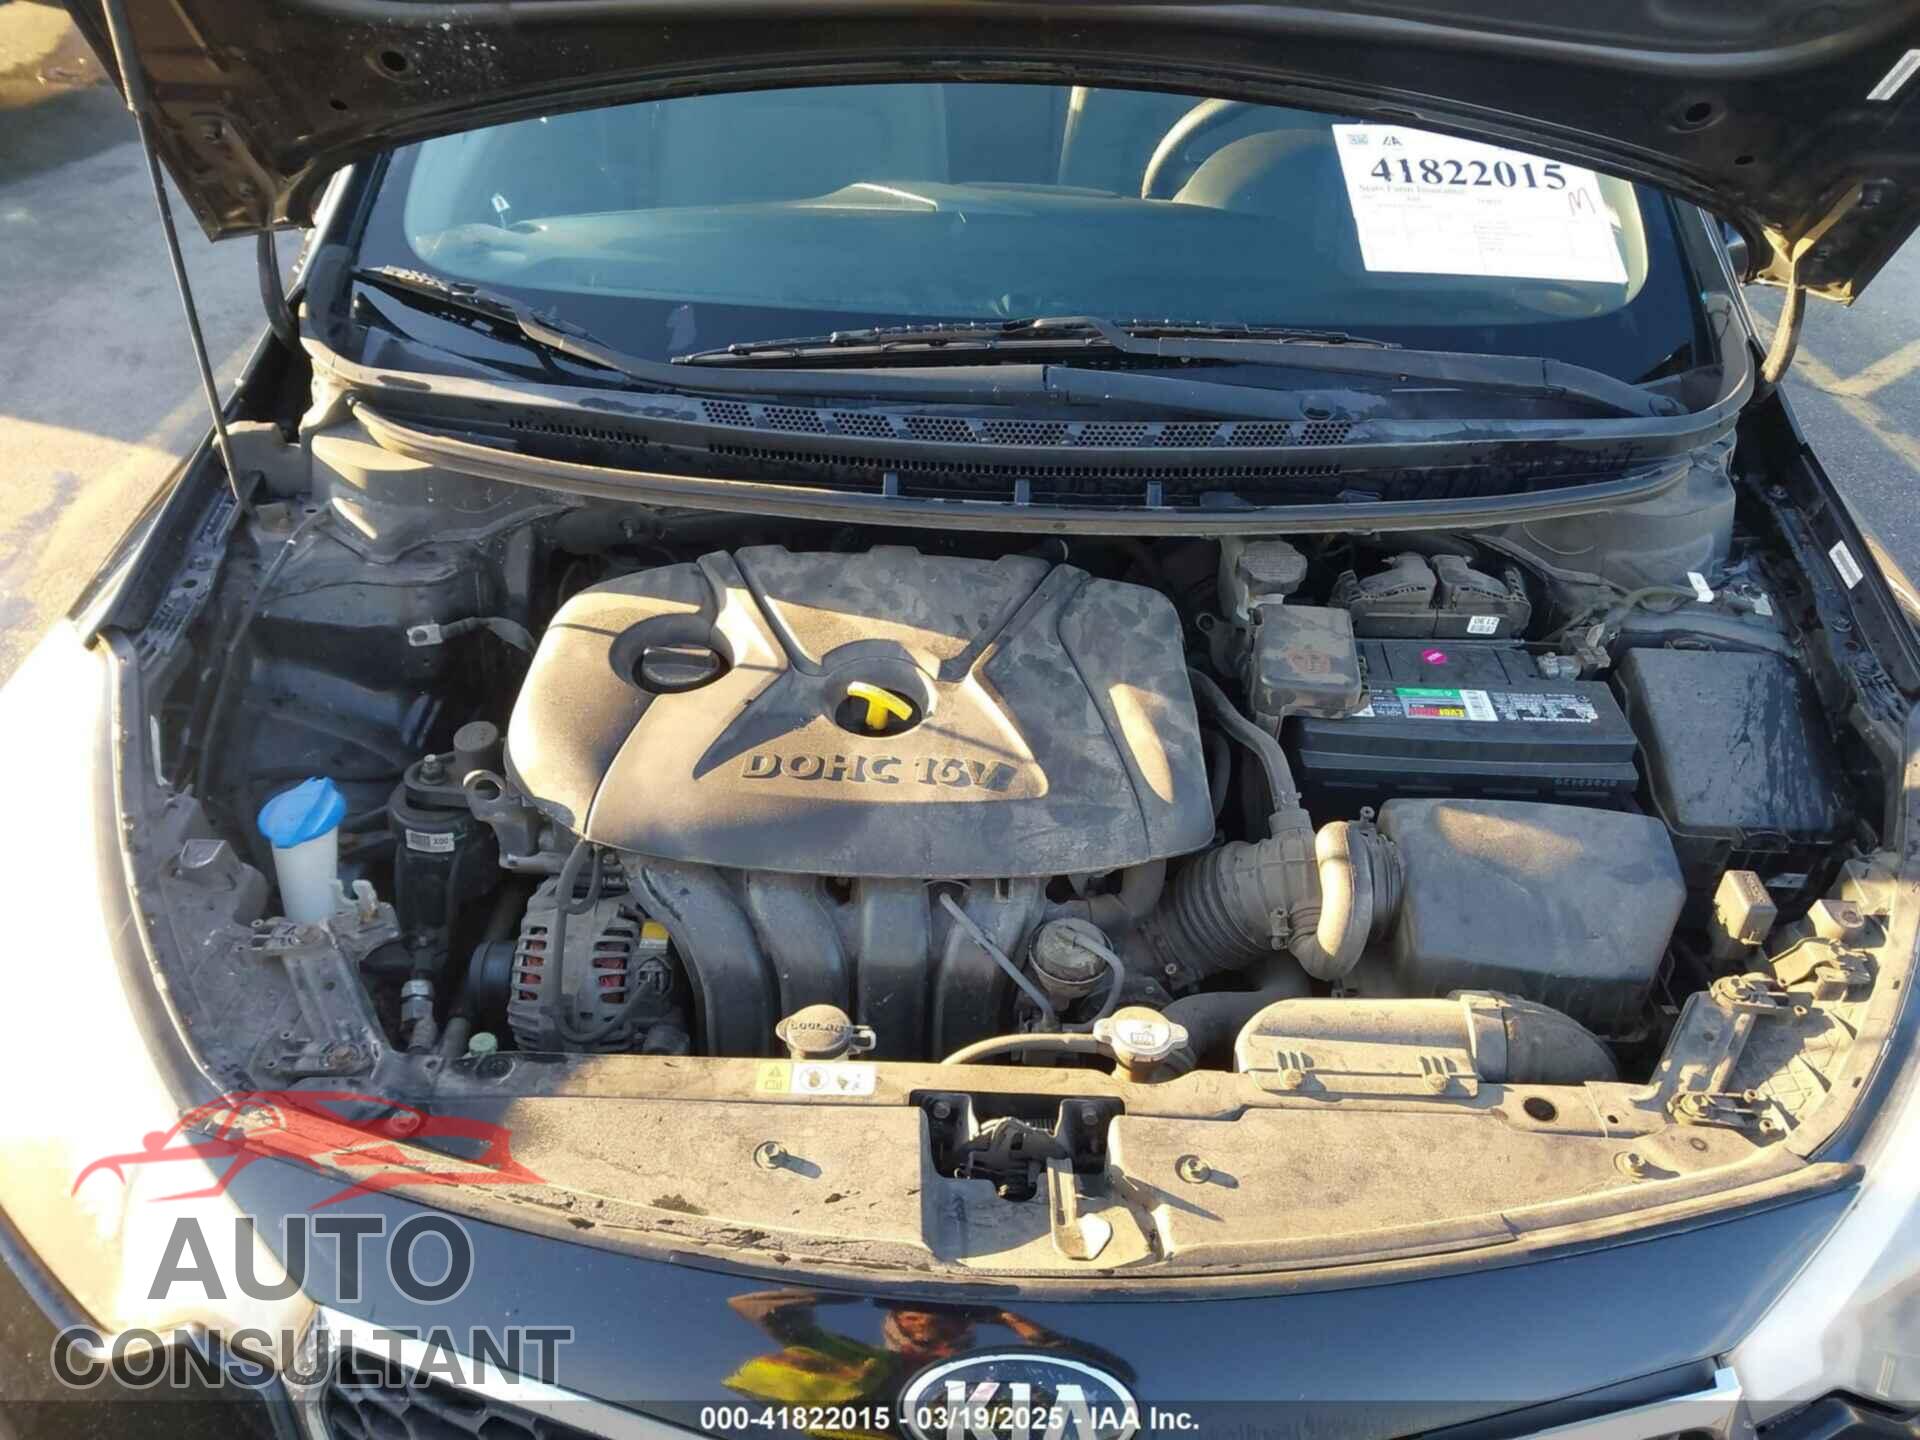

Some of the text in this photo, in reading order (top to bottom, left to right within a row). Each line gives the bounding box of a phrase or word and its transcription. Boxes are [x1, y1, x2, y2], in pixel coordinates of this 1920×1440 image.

[1370, 157, 1567, 190] 41822015
[741, 752, 1017, 792] DOHC 16V
[944, 1380, 1097, 1440] KIA
